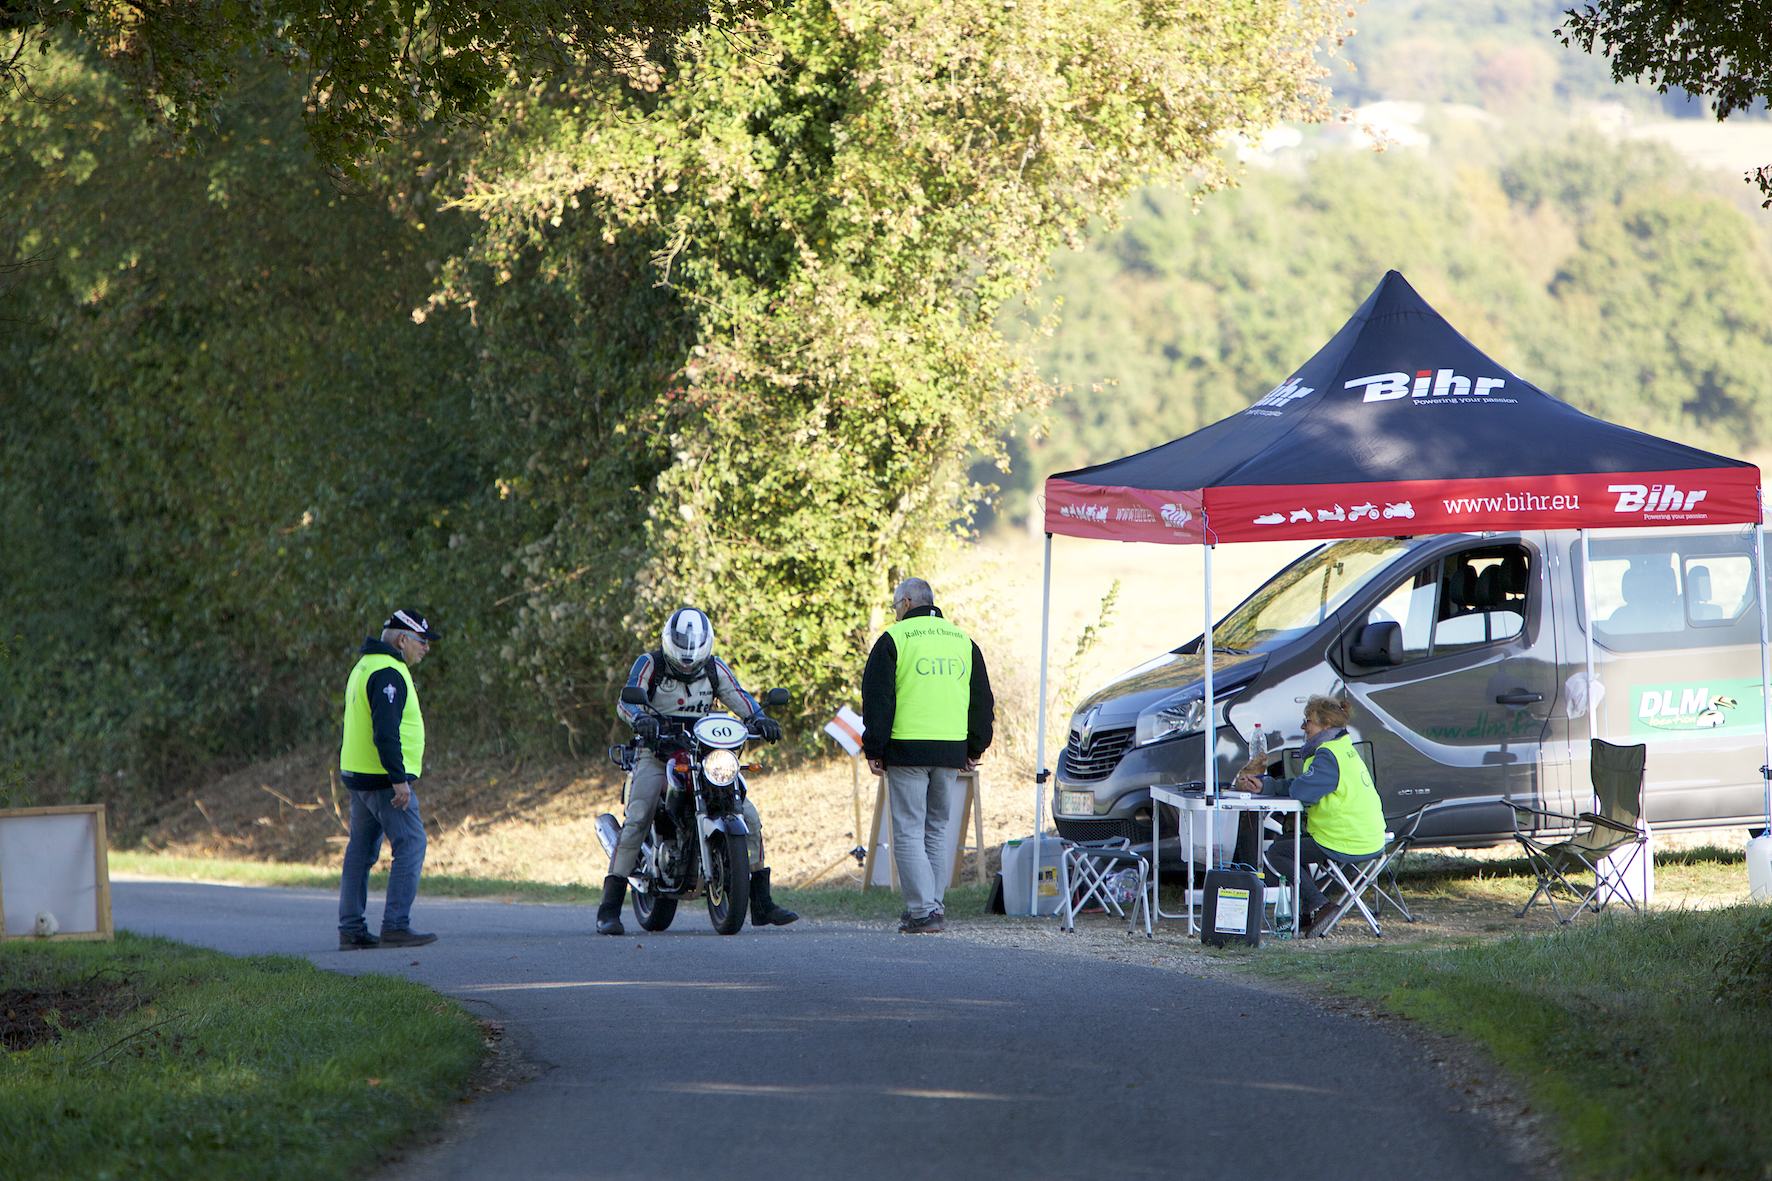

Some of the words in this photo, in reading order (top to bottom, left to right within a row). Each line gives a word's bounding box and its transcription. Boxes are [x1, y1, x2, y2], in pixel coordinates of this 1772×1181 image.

[1248, 377, 1315, 408] ihr
[1344, 368, 1506, 403] Bihr
[1412, 397, 1458, 406] Powering
[1482, 397, 1519, 405] passion
[1443, 492, 1580, 515] www.bihr.eu
[1607, 484, 1708, 513] Bihr
[904, 628, 927, 639] Rallye
[927, 627, 936, 635] de
[1638, 687, 1709, 718] DLM
[711, 726, 732, 738] 60
